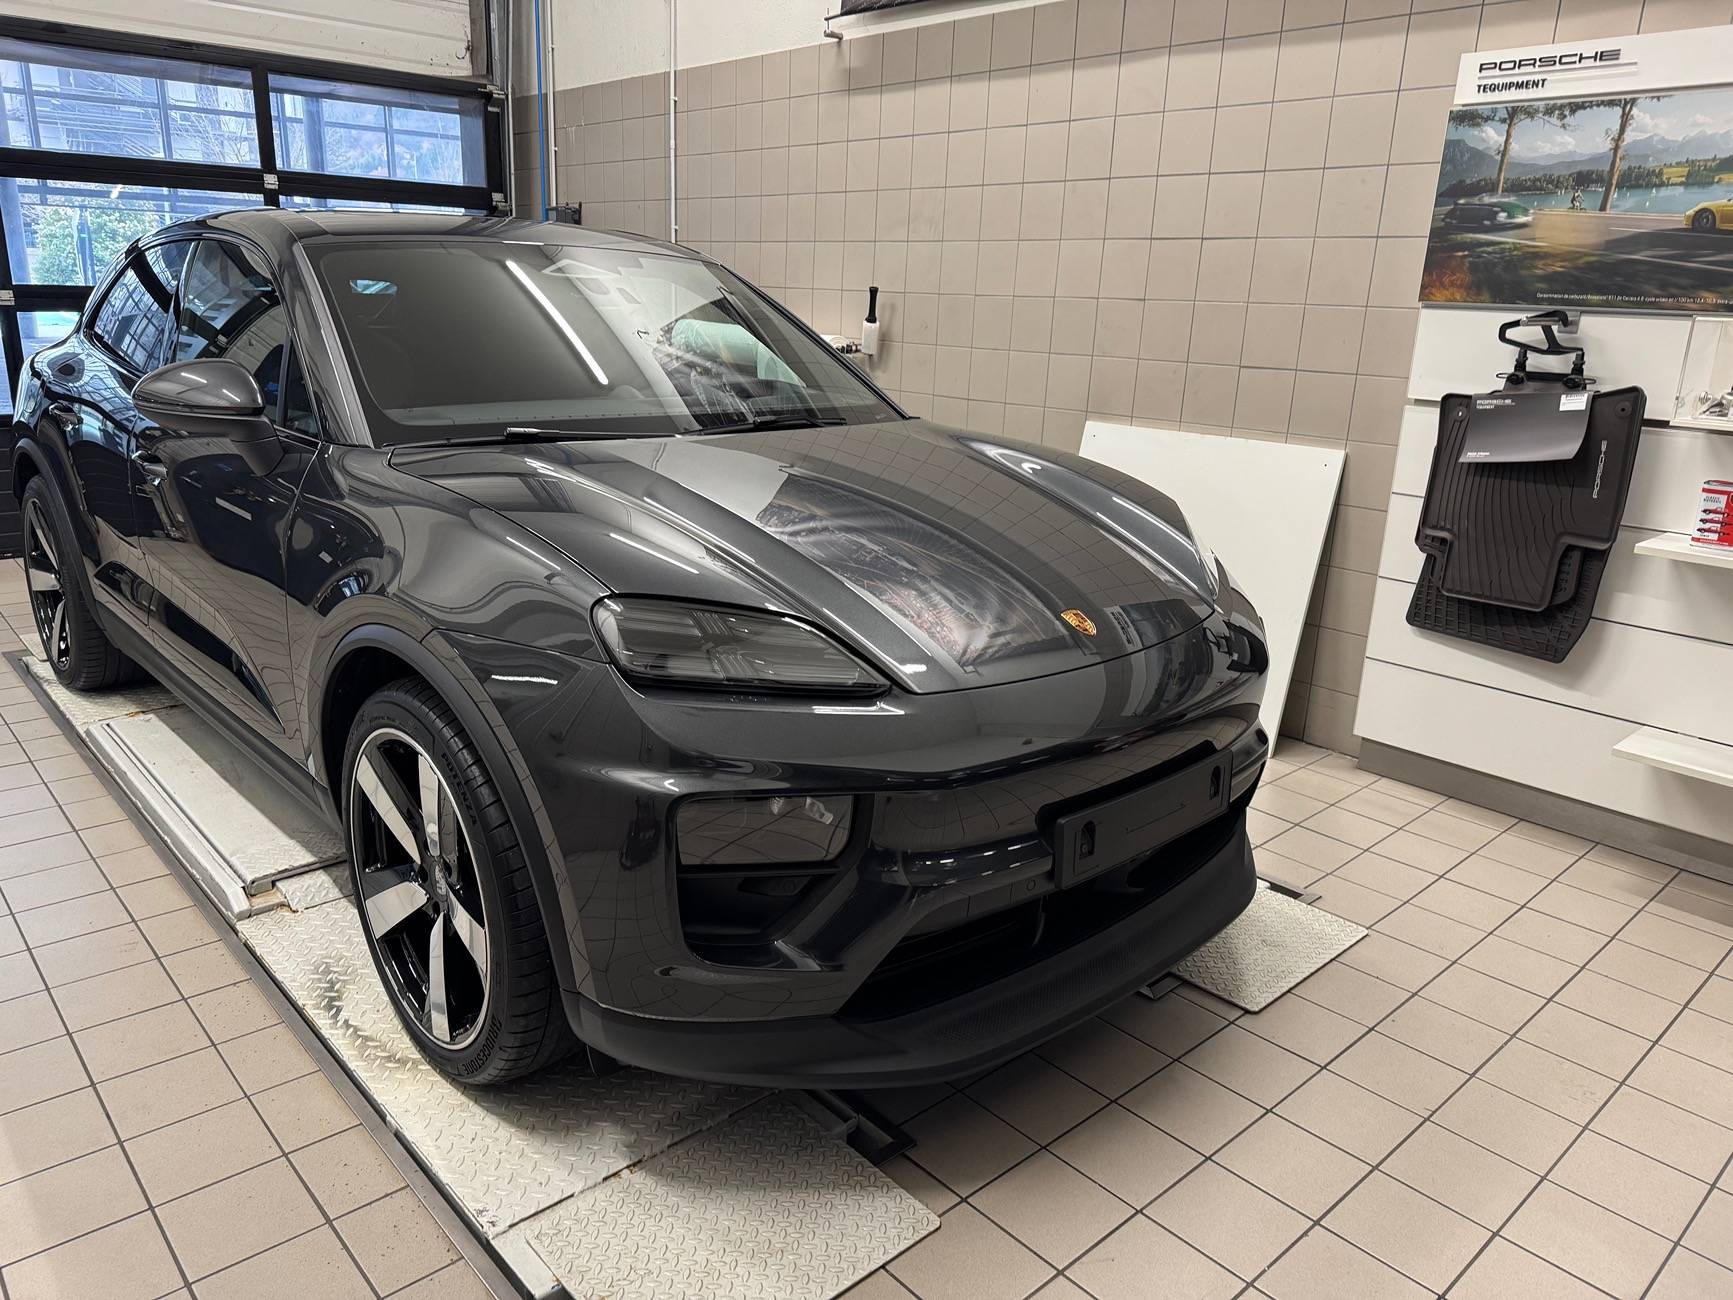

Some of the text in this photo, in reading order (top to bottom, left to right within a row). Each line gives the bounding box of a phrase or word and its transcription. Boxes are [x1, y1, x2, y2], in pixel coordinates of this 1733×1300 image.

[1476, 78, 1548, 94] TEQUIPMENT
[1478, 48, 1622, 73] PORSCHE
[1592, 440, 1608, 499] PORSCHE
[441, 752, 477, 826] POTENZA
[462, 1013, 503, 1075] BRIDGESTONE
